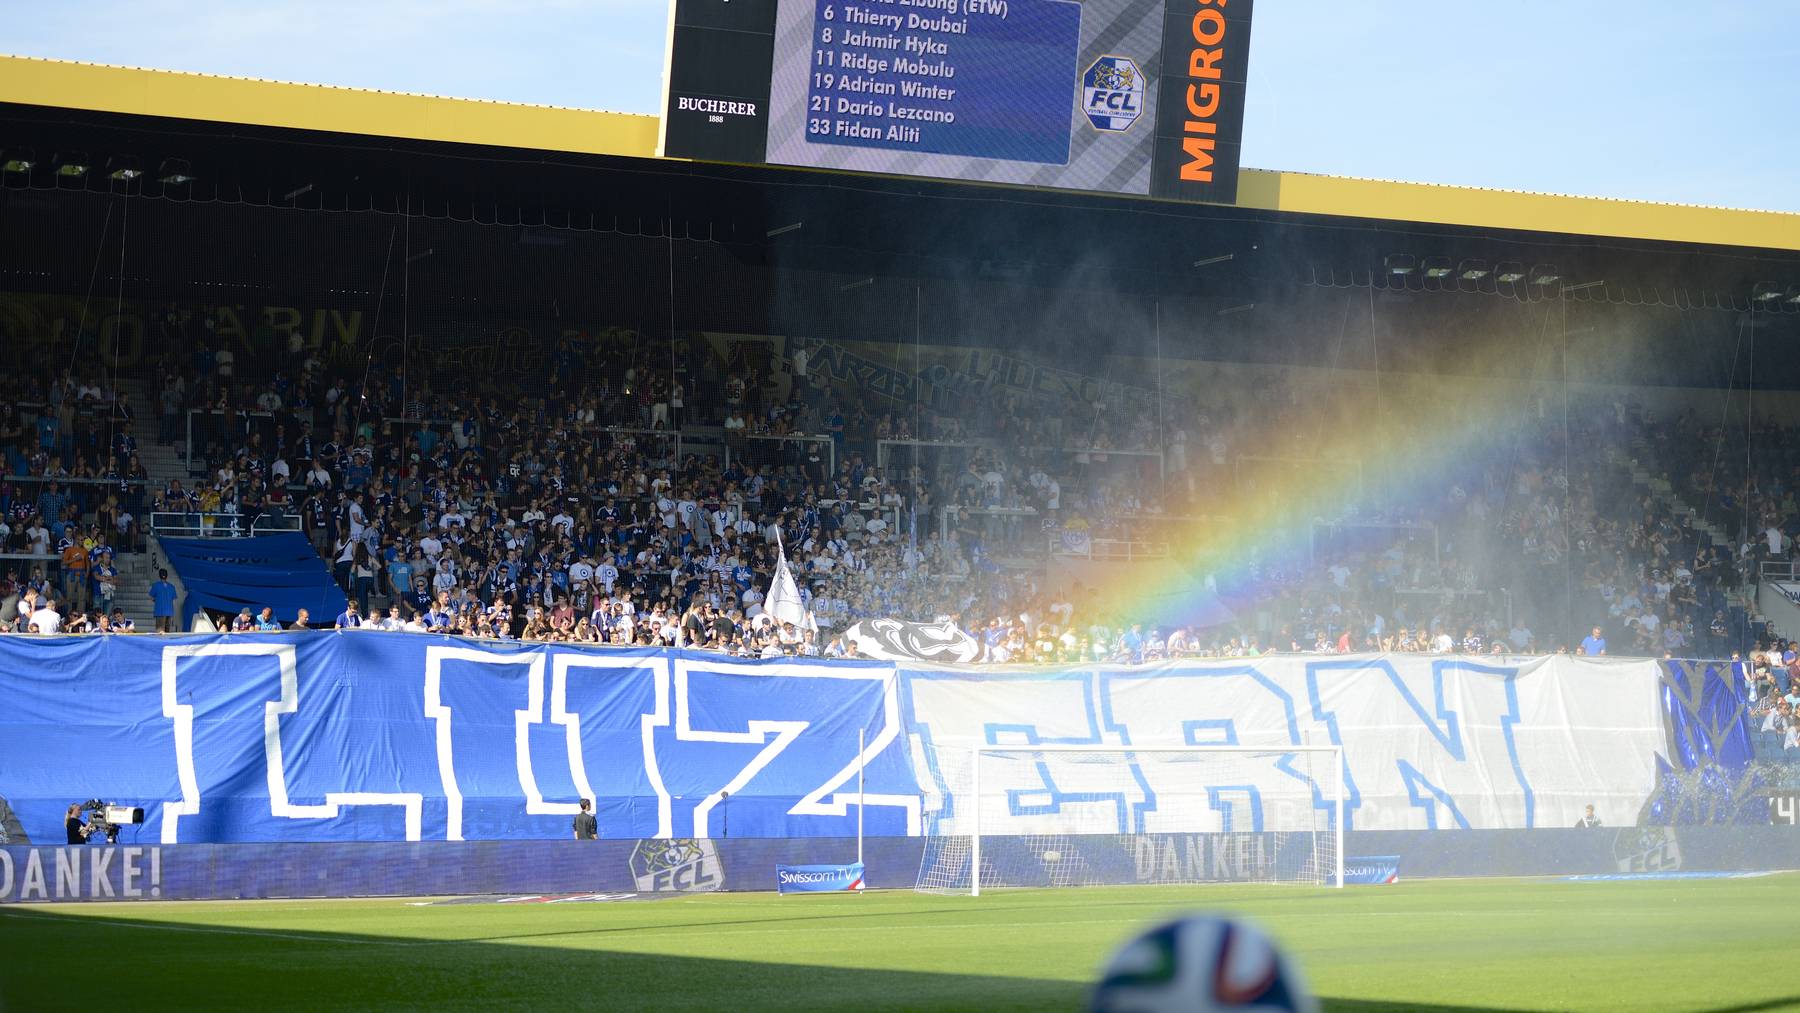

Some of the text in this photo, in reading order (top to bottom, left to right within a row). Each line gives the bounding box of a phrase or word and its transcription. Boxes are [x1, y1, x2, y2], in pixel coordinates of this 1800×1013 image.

[823, 4, 967, 34] 6 Thierry Doubai
[822, 28, 948, 56] 8 Jahmir Hyka
[816, 50, 955, 78] 11 Ridge Mobulu
[815, 73, 956, 101] 19 Adrian Winter
[1090, 90, 1137, 111] FCL
[1180, 0, 1228, 183] MIGRO
[679, 97, 757, 116] BUCHERER
[709, 115, 724, 123] 1888
[811, 96, 955, 123] 21 Dario Lezcano
[809, 118, 920, 143] 33 Fidan Aliti
[1135, 835, 1265, 880] DANKE!
[653, 860, 714, 891] FCL
[780, 867, 853, 884] Swisscom TV
